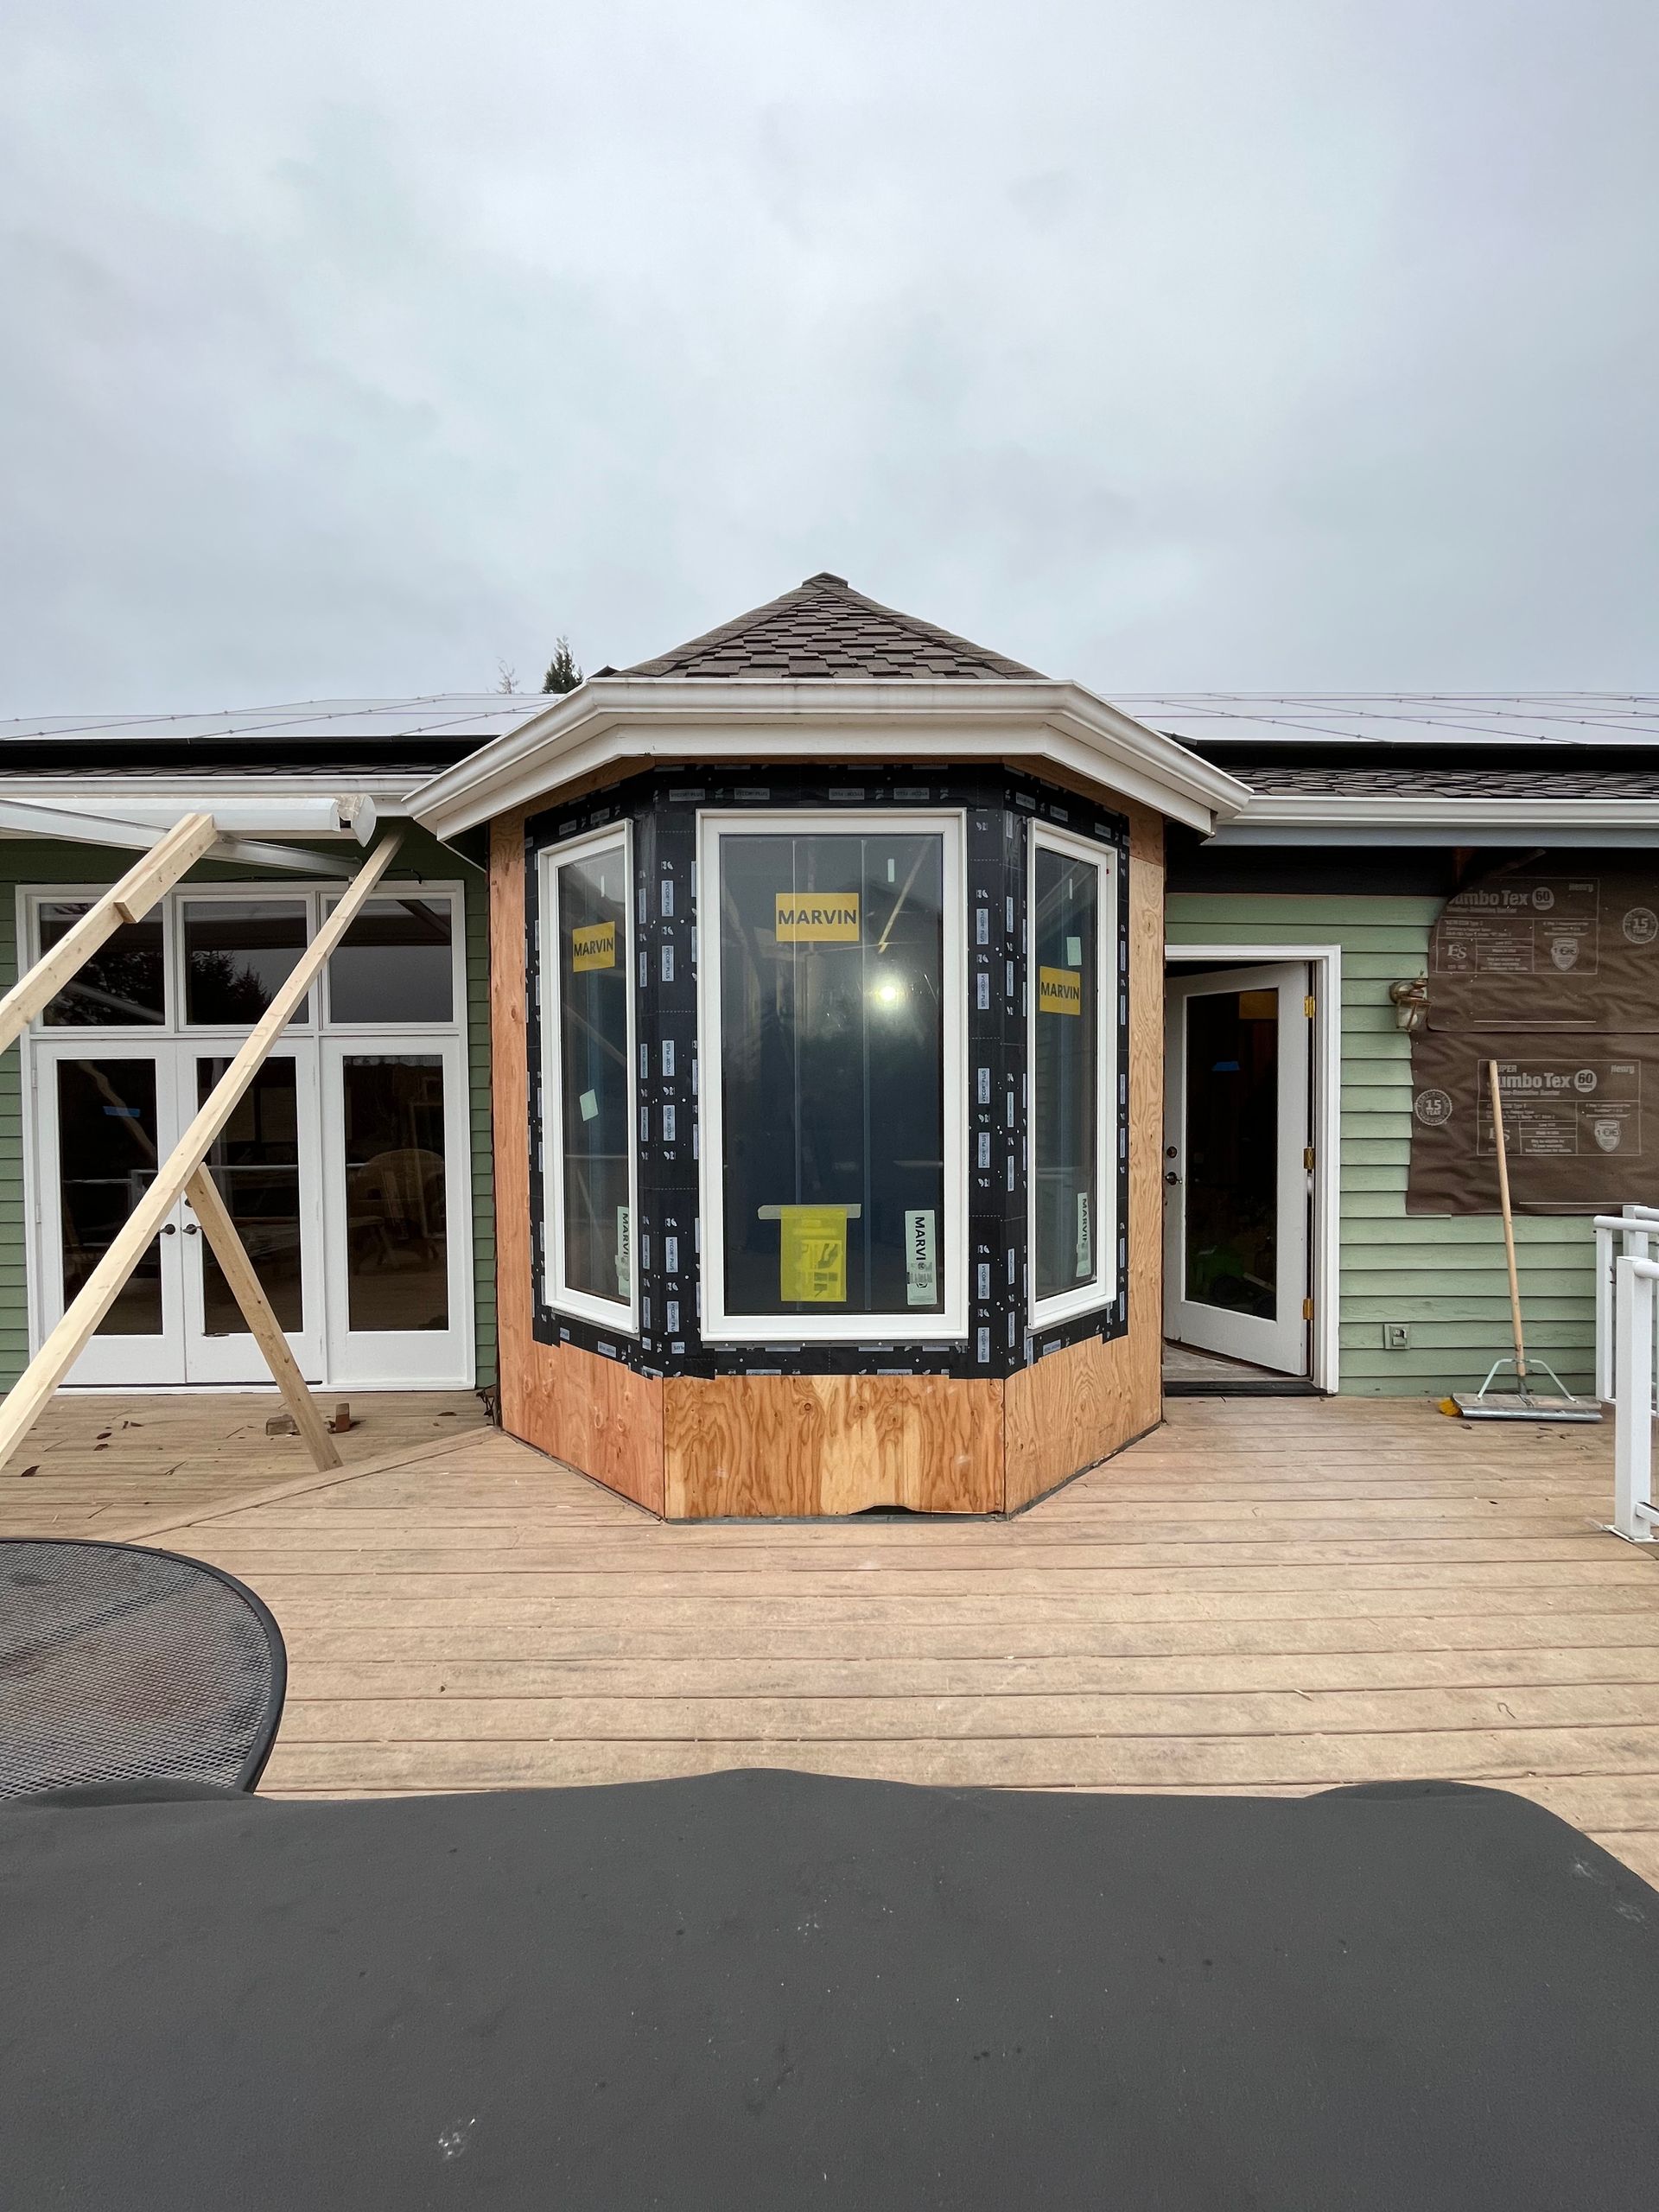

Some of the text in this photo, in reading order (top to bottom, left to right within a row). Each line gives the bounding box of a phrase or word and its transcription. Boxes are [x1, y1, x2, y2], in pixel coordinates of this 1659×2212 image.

[1501, 890, 1529, 905] Tex
[1536, 891, 1550, 901] 60
[778, 909, 856, 924] MARVIN
[1633, 918, 1648, 928] 15
[573, 938, 613, 957] MARVIN
[1040, 982, 1080, 1000] MARVIN
[1611, 1065, 1635, 1074] Henry
[1488, 1073, 1571, 1088] umbo Tex
[1579, 1074, 1593, 1083] 60
[1426, 1100, 1441, 1110] 15
